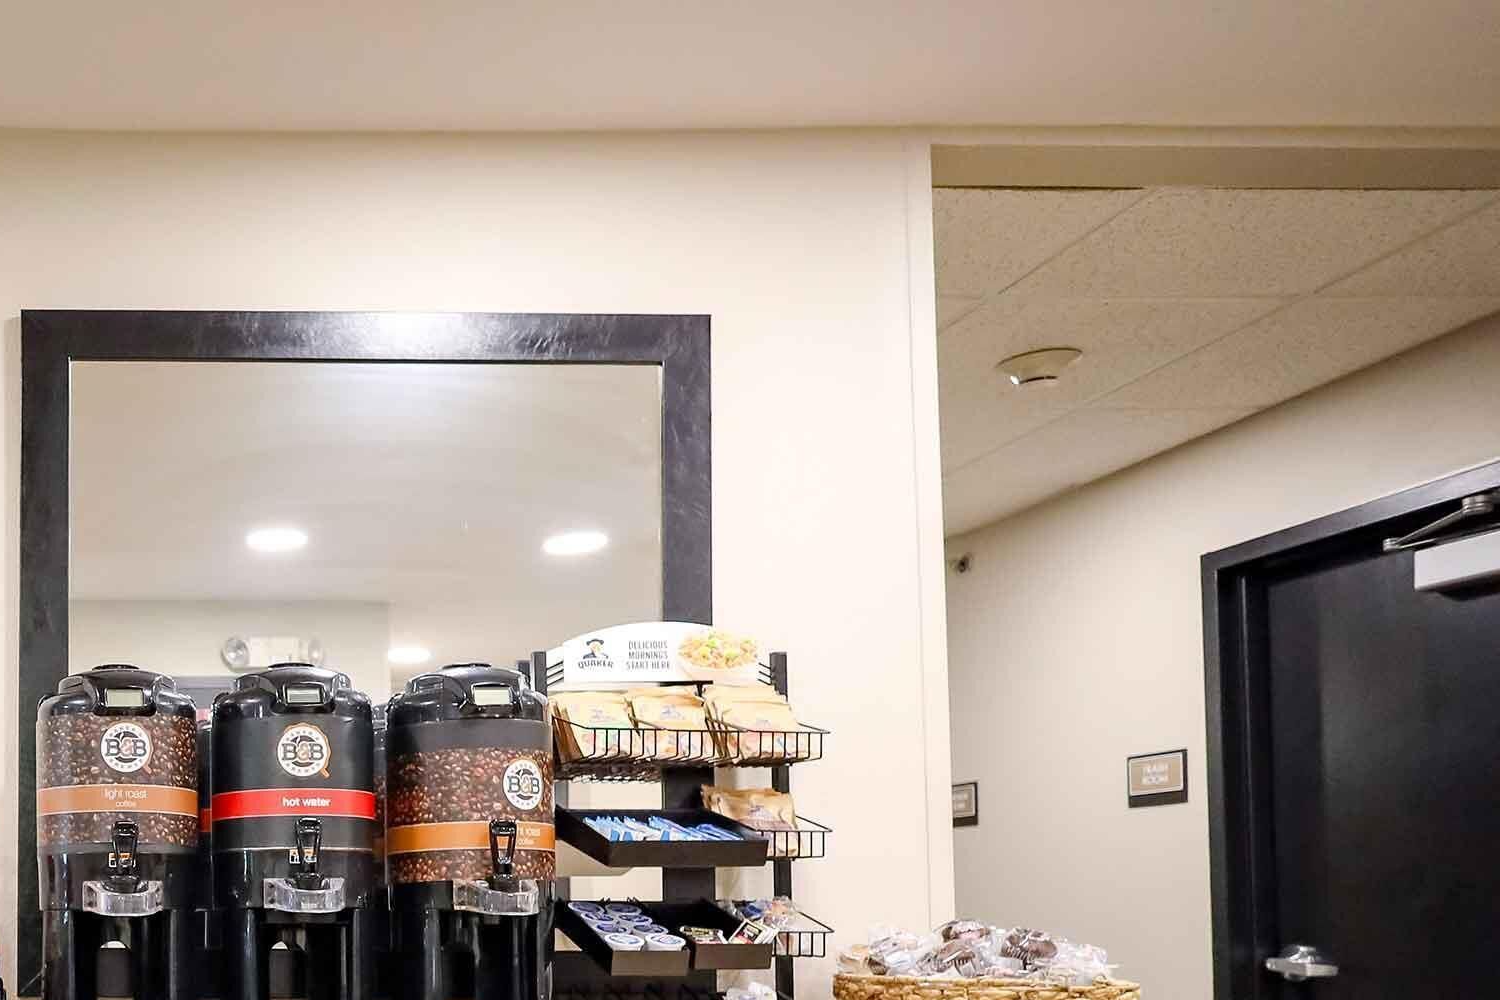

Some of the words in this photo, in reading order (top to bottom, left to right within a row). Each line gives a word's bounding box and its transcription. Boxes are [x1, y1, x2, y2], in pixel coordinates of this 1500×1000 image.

[578, 660, 614, 670] QUAKER
[282, 796, 300, 807] hot
[301, 797, 331, 807] water
